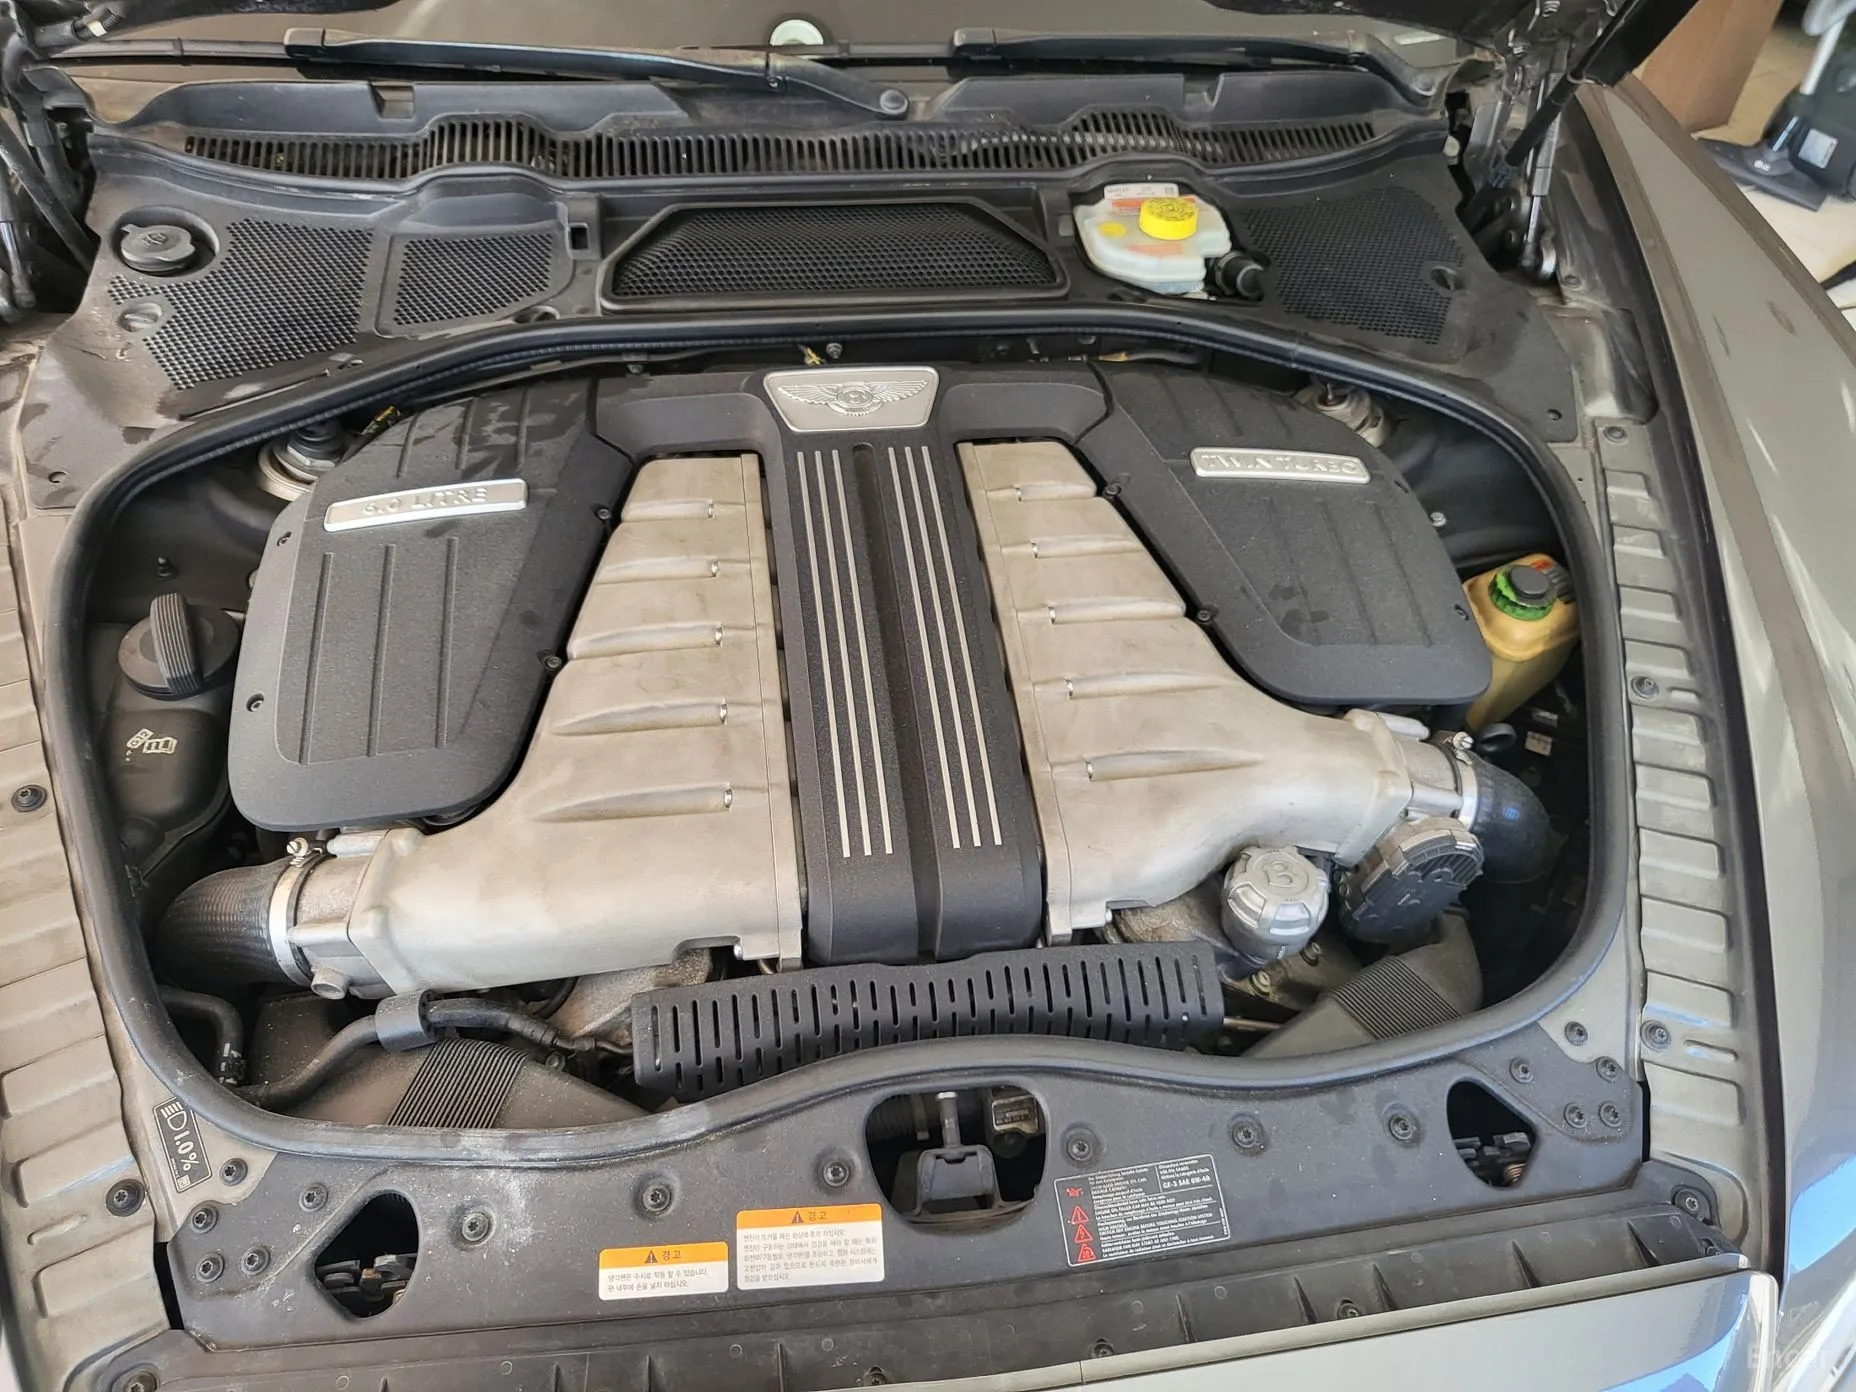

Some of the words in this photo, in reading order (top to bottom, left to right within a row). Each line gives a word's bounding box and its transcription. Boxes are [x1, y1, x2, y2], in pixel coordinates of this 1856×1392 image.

[363, 498, 401, 517] 6.0
[411, 487, 488, 511] LITRE
[174, 1130, 200, 1171] 1.0%
[1178, 1178, 1191, 1186] SAE
[662, 1250, 681, 1260] 경고
